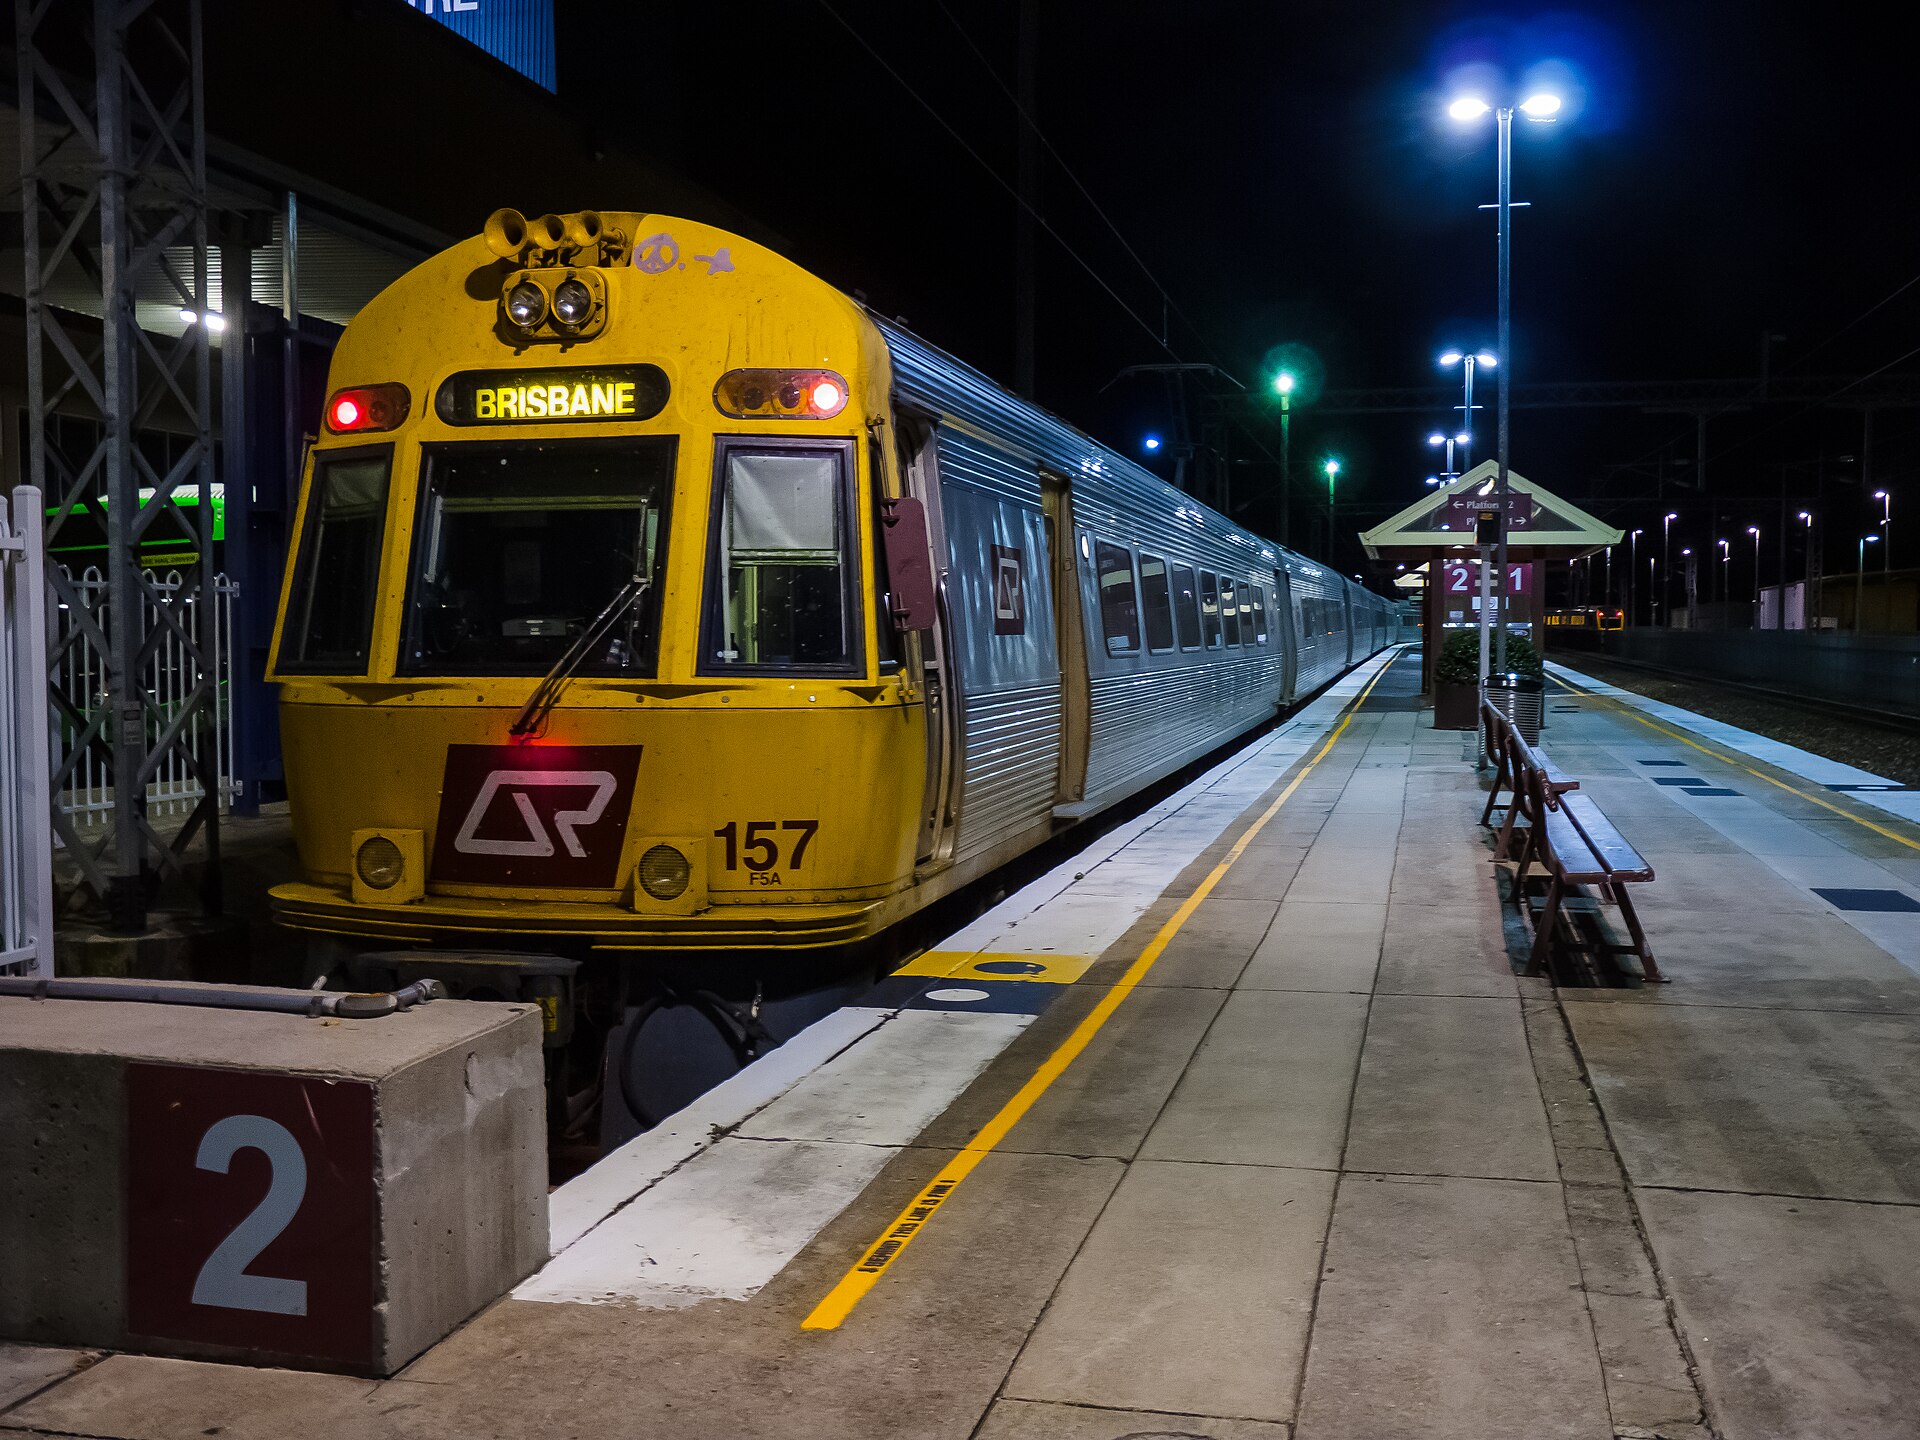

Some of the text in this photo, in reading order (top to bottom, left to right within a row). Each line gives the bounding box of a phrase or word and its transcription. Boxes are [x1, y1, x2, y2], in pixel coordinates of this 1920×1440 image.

[476, 383, 635, 418] BRISBANE
[1508, 501, 1515, 509] 2
[1451, 568, 1468, 591] 2
[1509, 567, 1522, 591] 1
[714, 820, 819, 871] 157
[749, 872, 782, 886] F5A
[192, 1114, 308, 1316] 2
[863, 1240, 903, 1267] BEHIND
[889, 1223, 919, 1238] THIS
[905, 1207, 935, 1221] LINE
